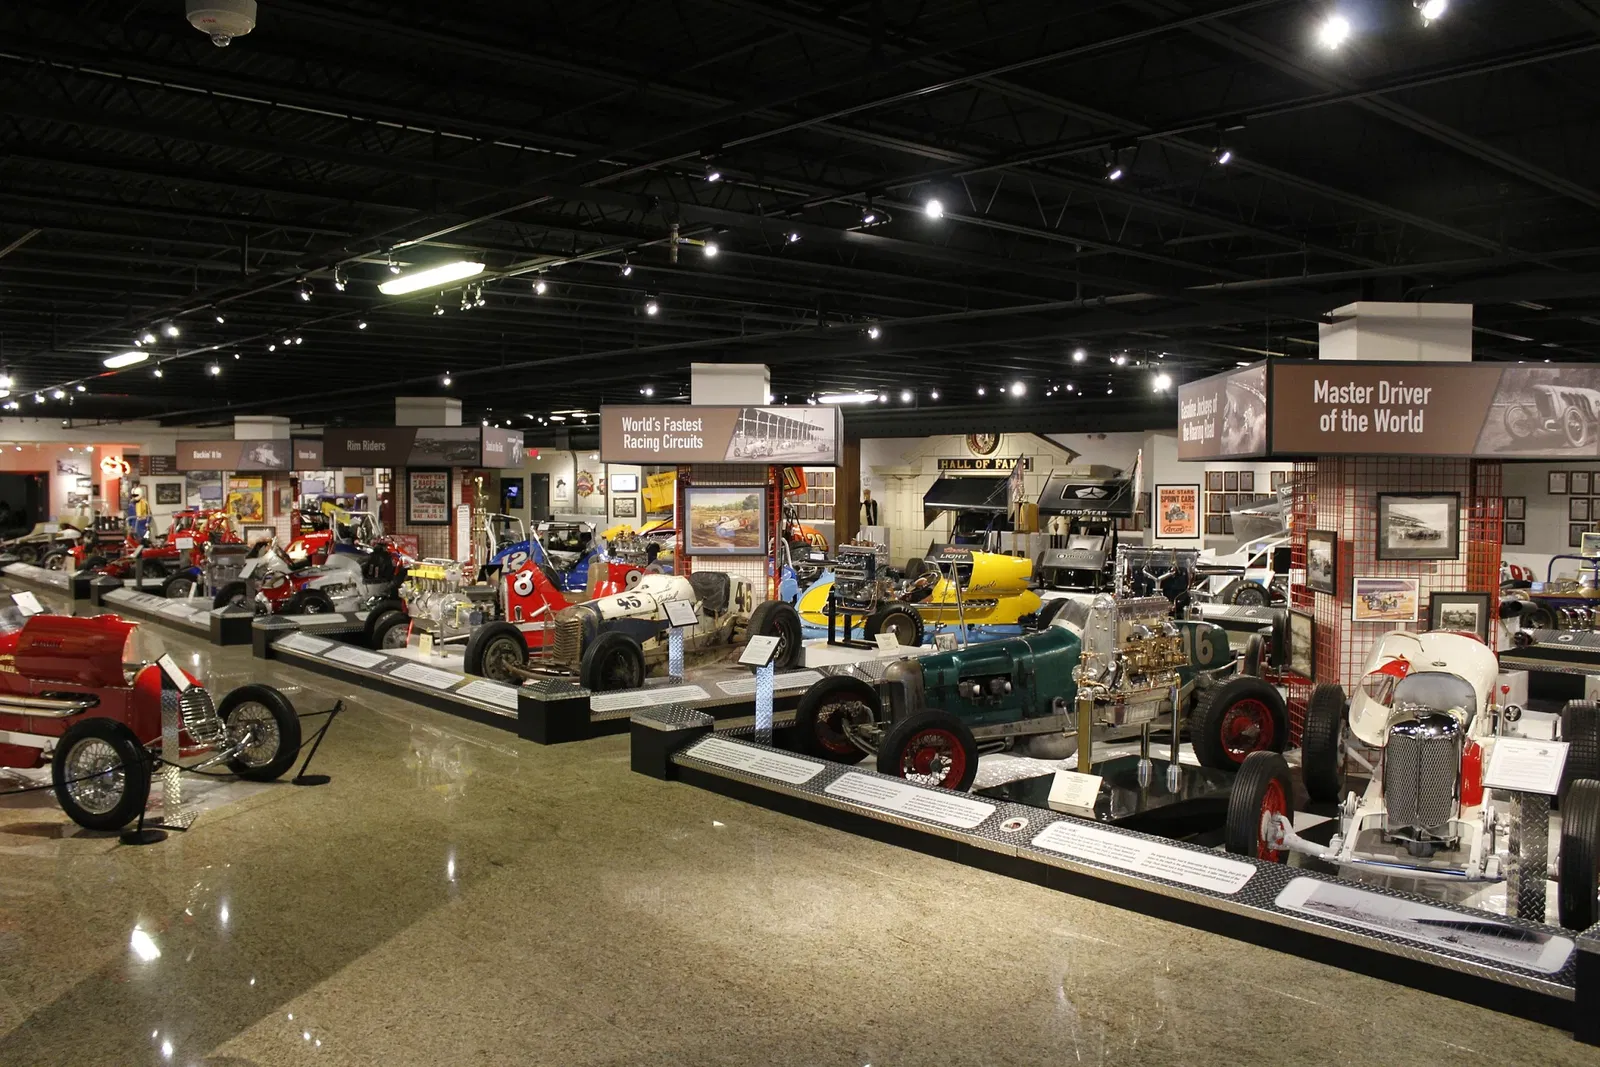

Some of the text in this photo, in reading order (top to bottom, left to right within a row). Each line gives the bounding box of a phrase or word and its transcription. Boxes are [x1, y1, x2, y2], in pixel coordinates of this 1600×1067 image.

[1313, 379, 1432, 405] Master Driver
[1181, 399, 1197, 420] Gasoline
[621, 416, 703, 432] World's Fastest
[1320, 408, 1424, 433] of the World
[346, 440, 386, 451] Rim Riders
[623, 433, 704, 452] Racing Circuits
[941, 460, 971, 469] HALL
[975, 460, 990, 469] OF
[1160, 495, 1196, 503] SPRINT CARS
[1060, 508, 1108, 516] GOODYEAR
[501, 551, 528, 572] 12
[513, 569, 534, 597] 8
[616, 595, 642, 610] 45
[735, 581, 752, 613] 45
